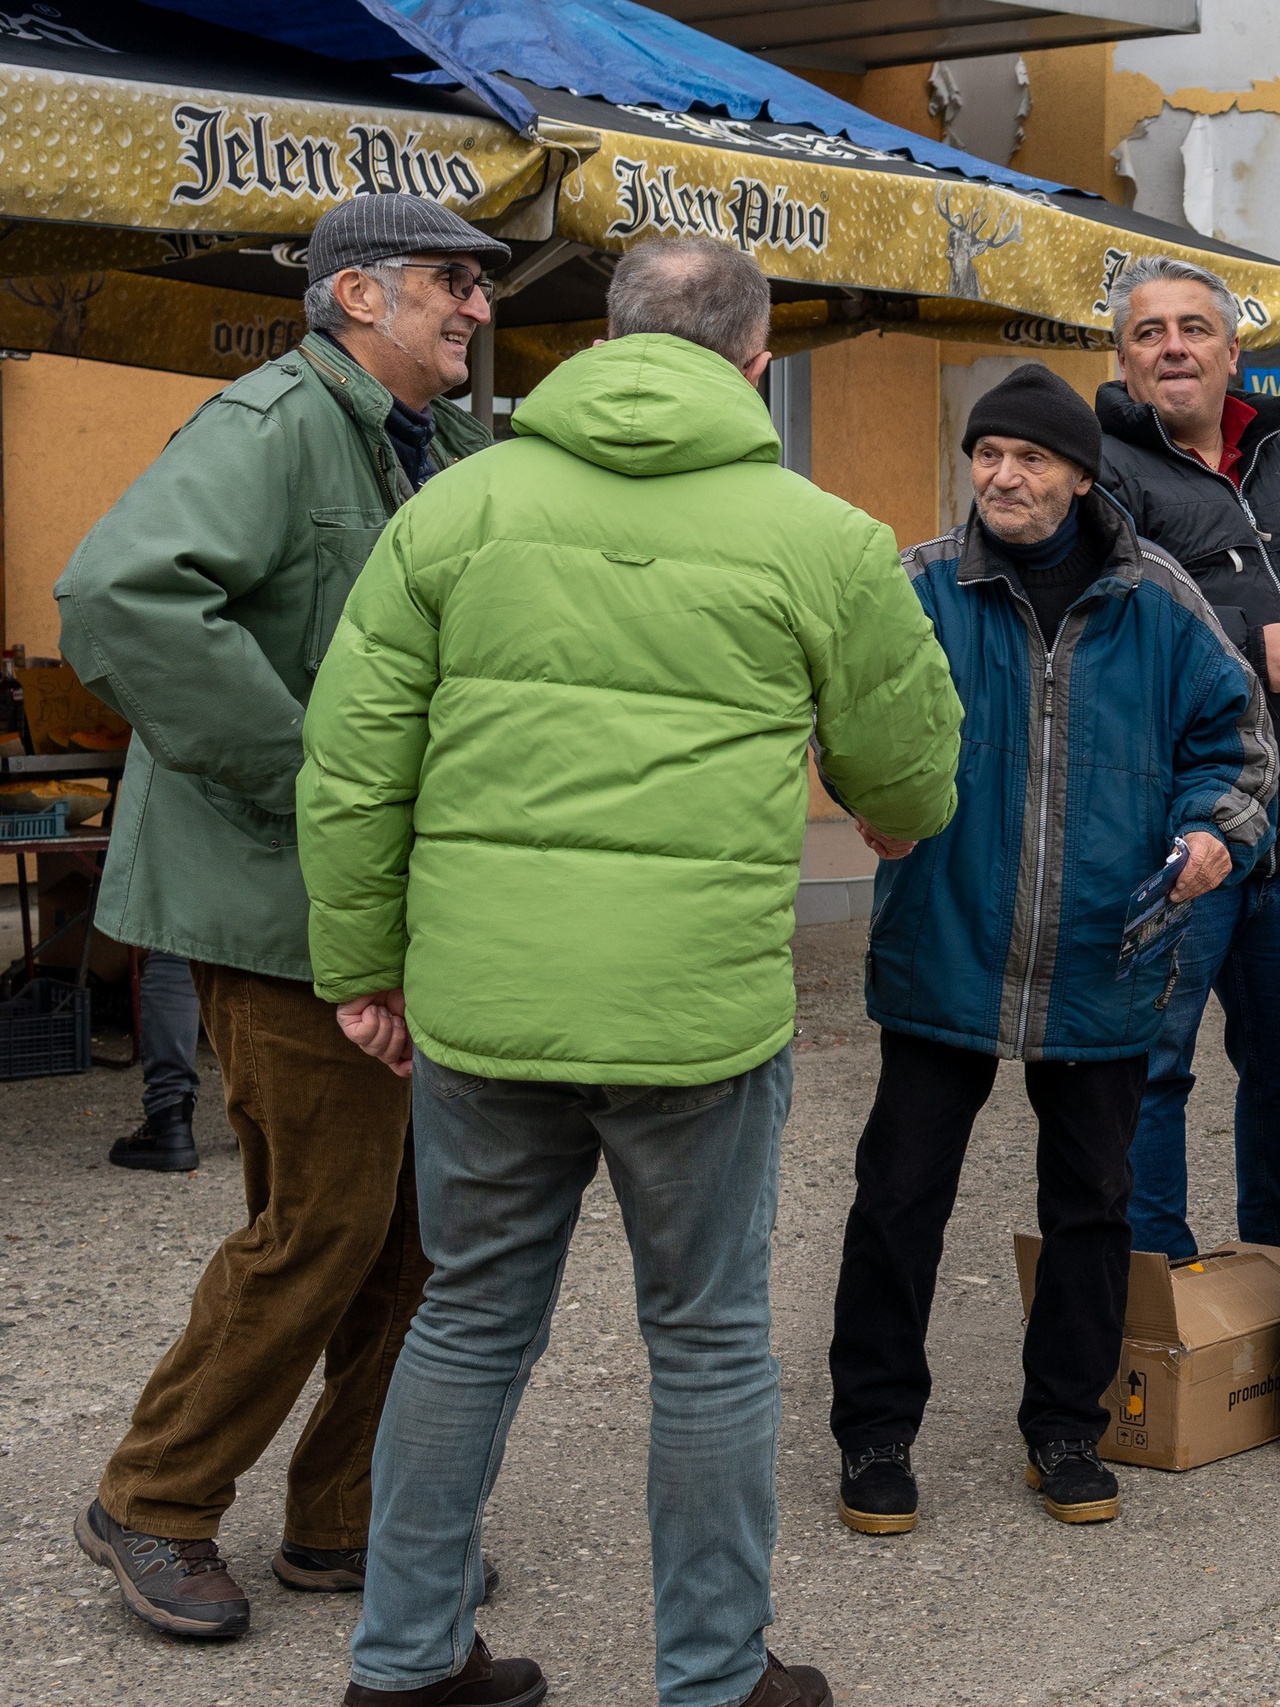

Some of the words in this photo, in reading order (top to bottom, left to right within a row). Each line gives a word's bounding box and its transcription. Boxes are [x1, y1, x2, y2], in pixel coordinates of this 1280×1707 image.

[171, 102, 348, 204] Jelen
[347, 124, 485, 205] Pivo
[605, 155, 729, 239] Jelen
[727, 177, 829, 256] Pivo
